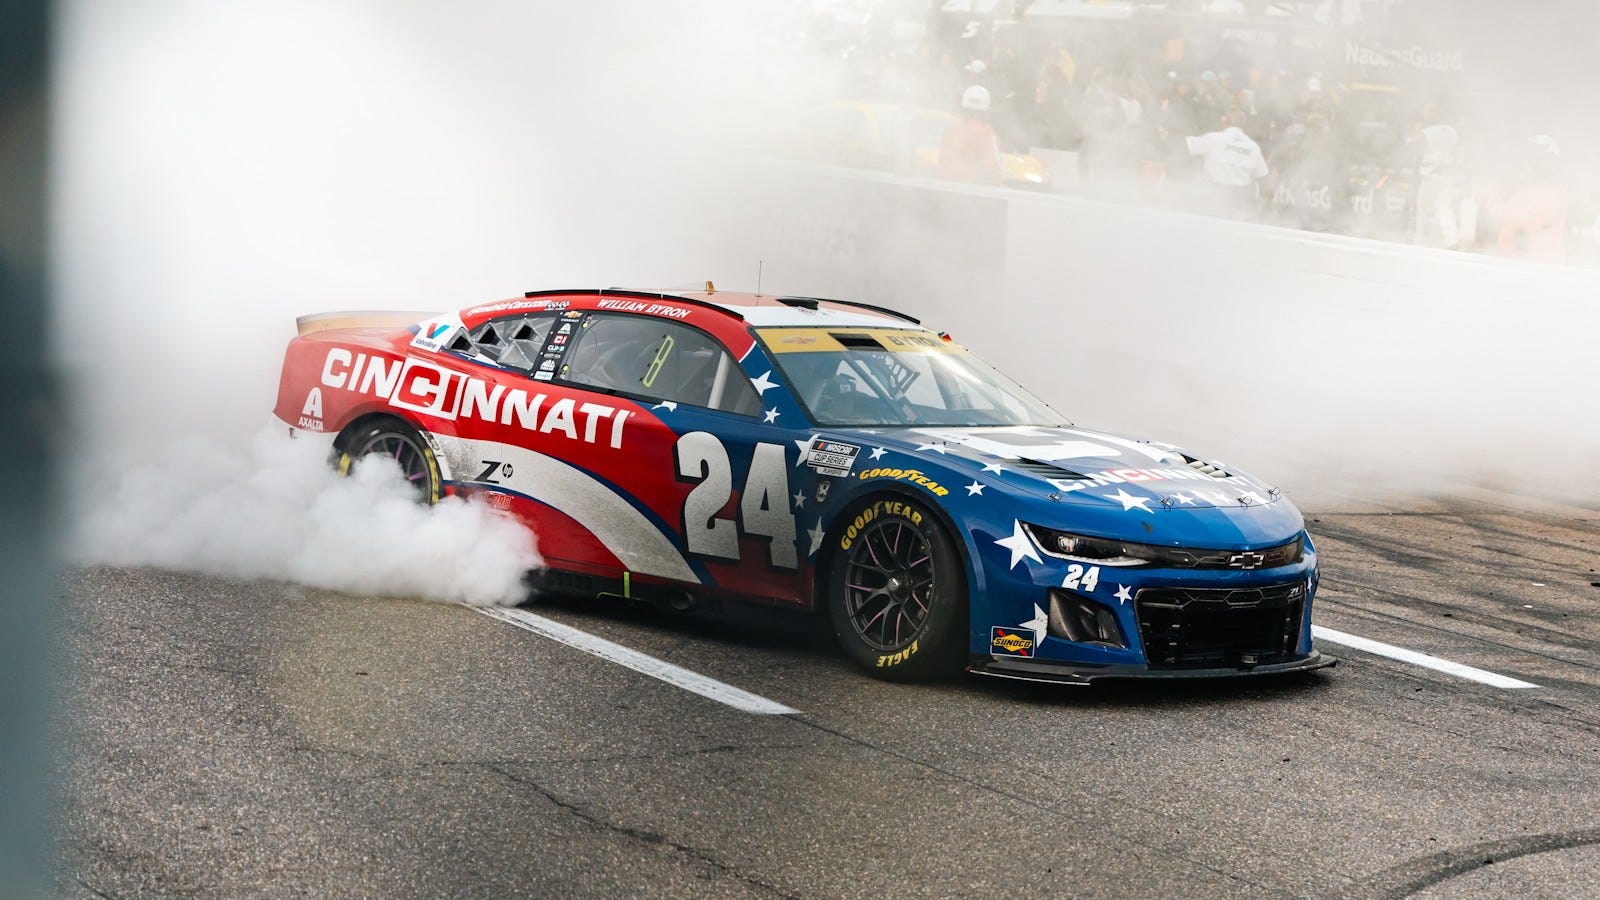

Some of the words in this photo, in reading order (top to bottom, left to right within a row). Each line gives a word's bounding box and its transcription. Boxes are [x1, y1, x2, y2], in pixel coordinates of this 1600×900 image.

[597, 299, 648, 312] WILLIAM
[645, 304, 692, 319] BYRON
[321, 347, 630, 450] CINCINNATI
[298, 416, 324, 432] AXALTA
[814, 453, 827, 462] CUP
[826, 456, 848, 466] SERIES
[827, 443, 853, 455] NASCAR
[859, 468, 949, 498] GOODYEAR
[677, 431, 798, 569] 24
[1061, 564, 1100, 592] 24
[876, 640, 919, 667] EAGLE
[992, 637, 1033, 651] SUNOCO
